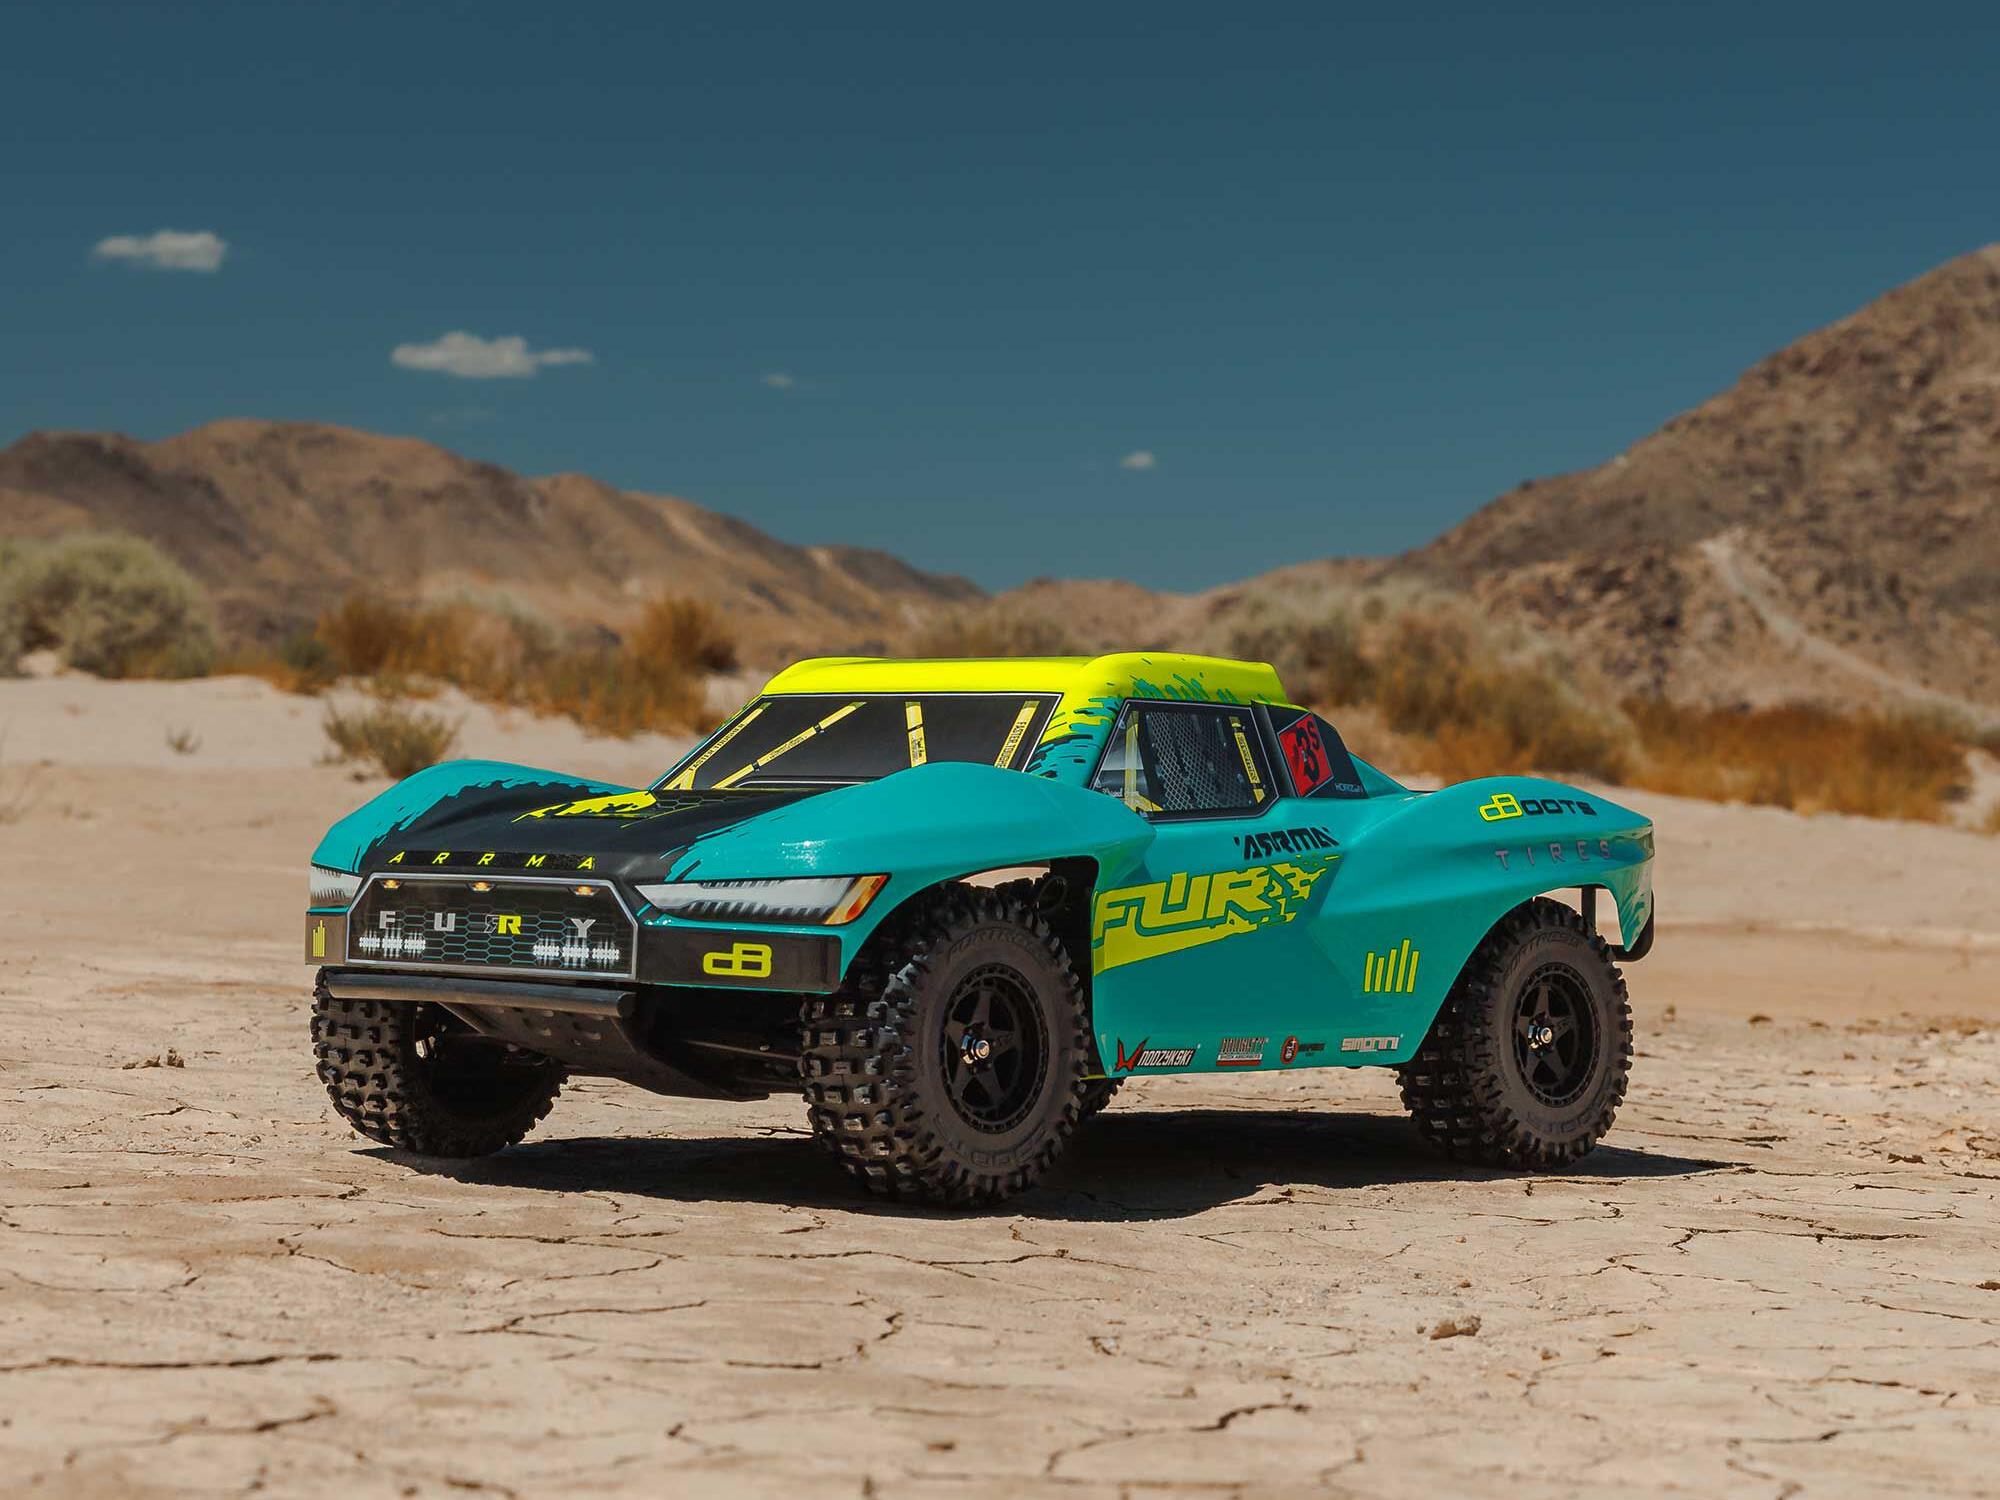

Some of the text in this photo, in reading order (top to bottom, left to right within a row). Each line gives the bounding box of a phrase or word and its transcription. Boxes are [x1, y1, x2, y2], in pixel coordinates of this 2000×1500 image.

[1241, 827, 1340, 861] ARRMA
[1495, 840, 1611, 870] TIRES
[388, 851, 596, 871] ARRMA
[379, 910, 597, 938] FURY
